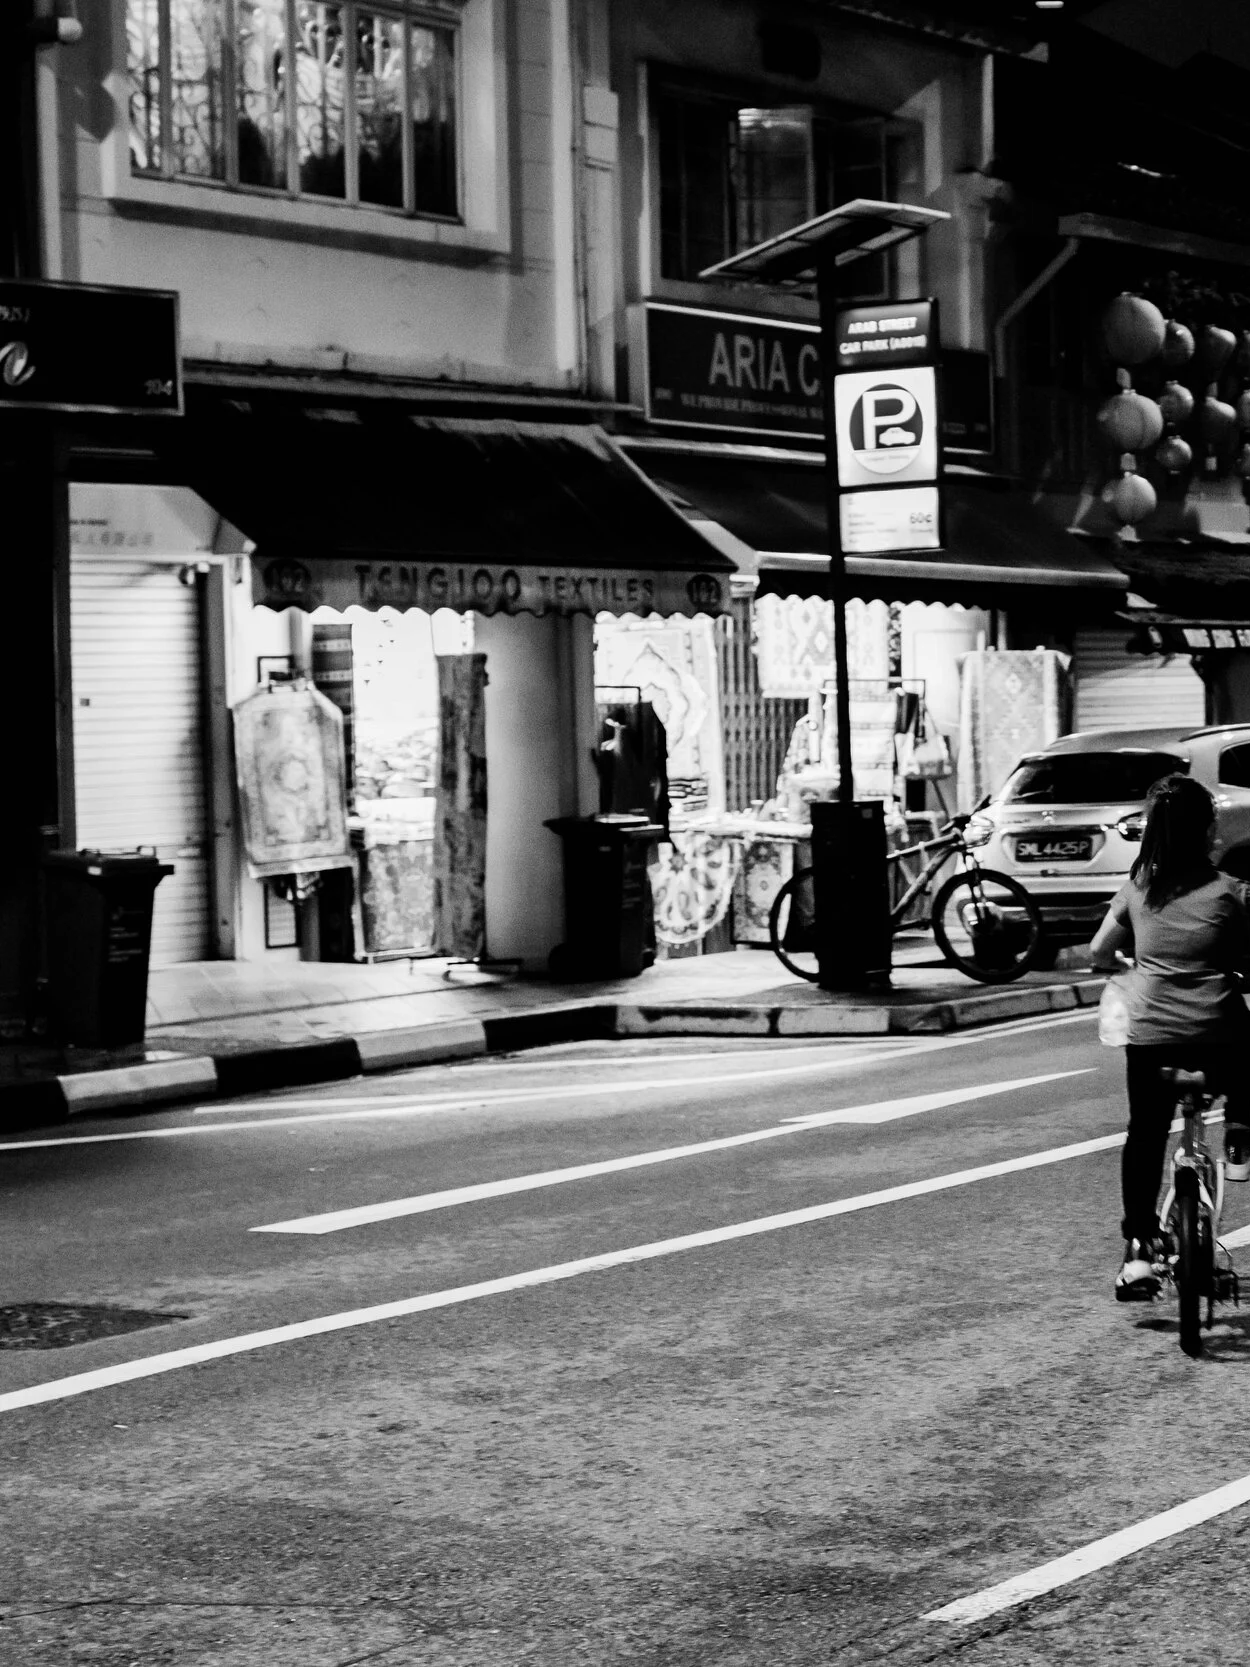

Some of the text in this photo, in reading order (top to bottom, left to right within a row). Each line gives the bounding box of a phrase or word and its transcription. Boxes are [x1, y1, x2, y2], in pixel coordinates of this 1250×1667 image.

[708, 332, 791, 394] ARIA
[839, 341, 861, 355] CAR
[862, 339, 889, 352] PARK
[862, 389, 916, 449] P
[537, 576, 655, 602] TEXTILES
